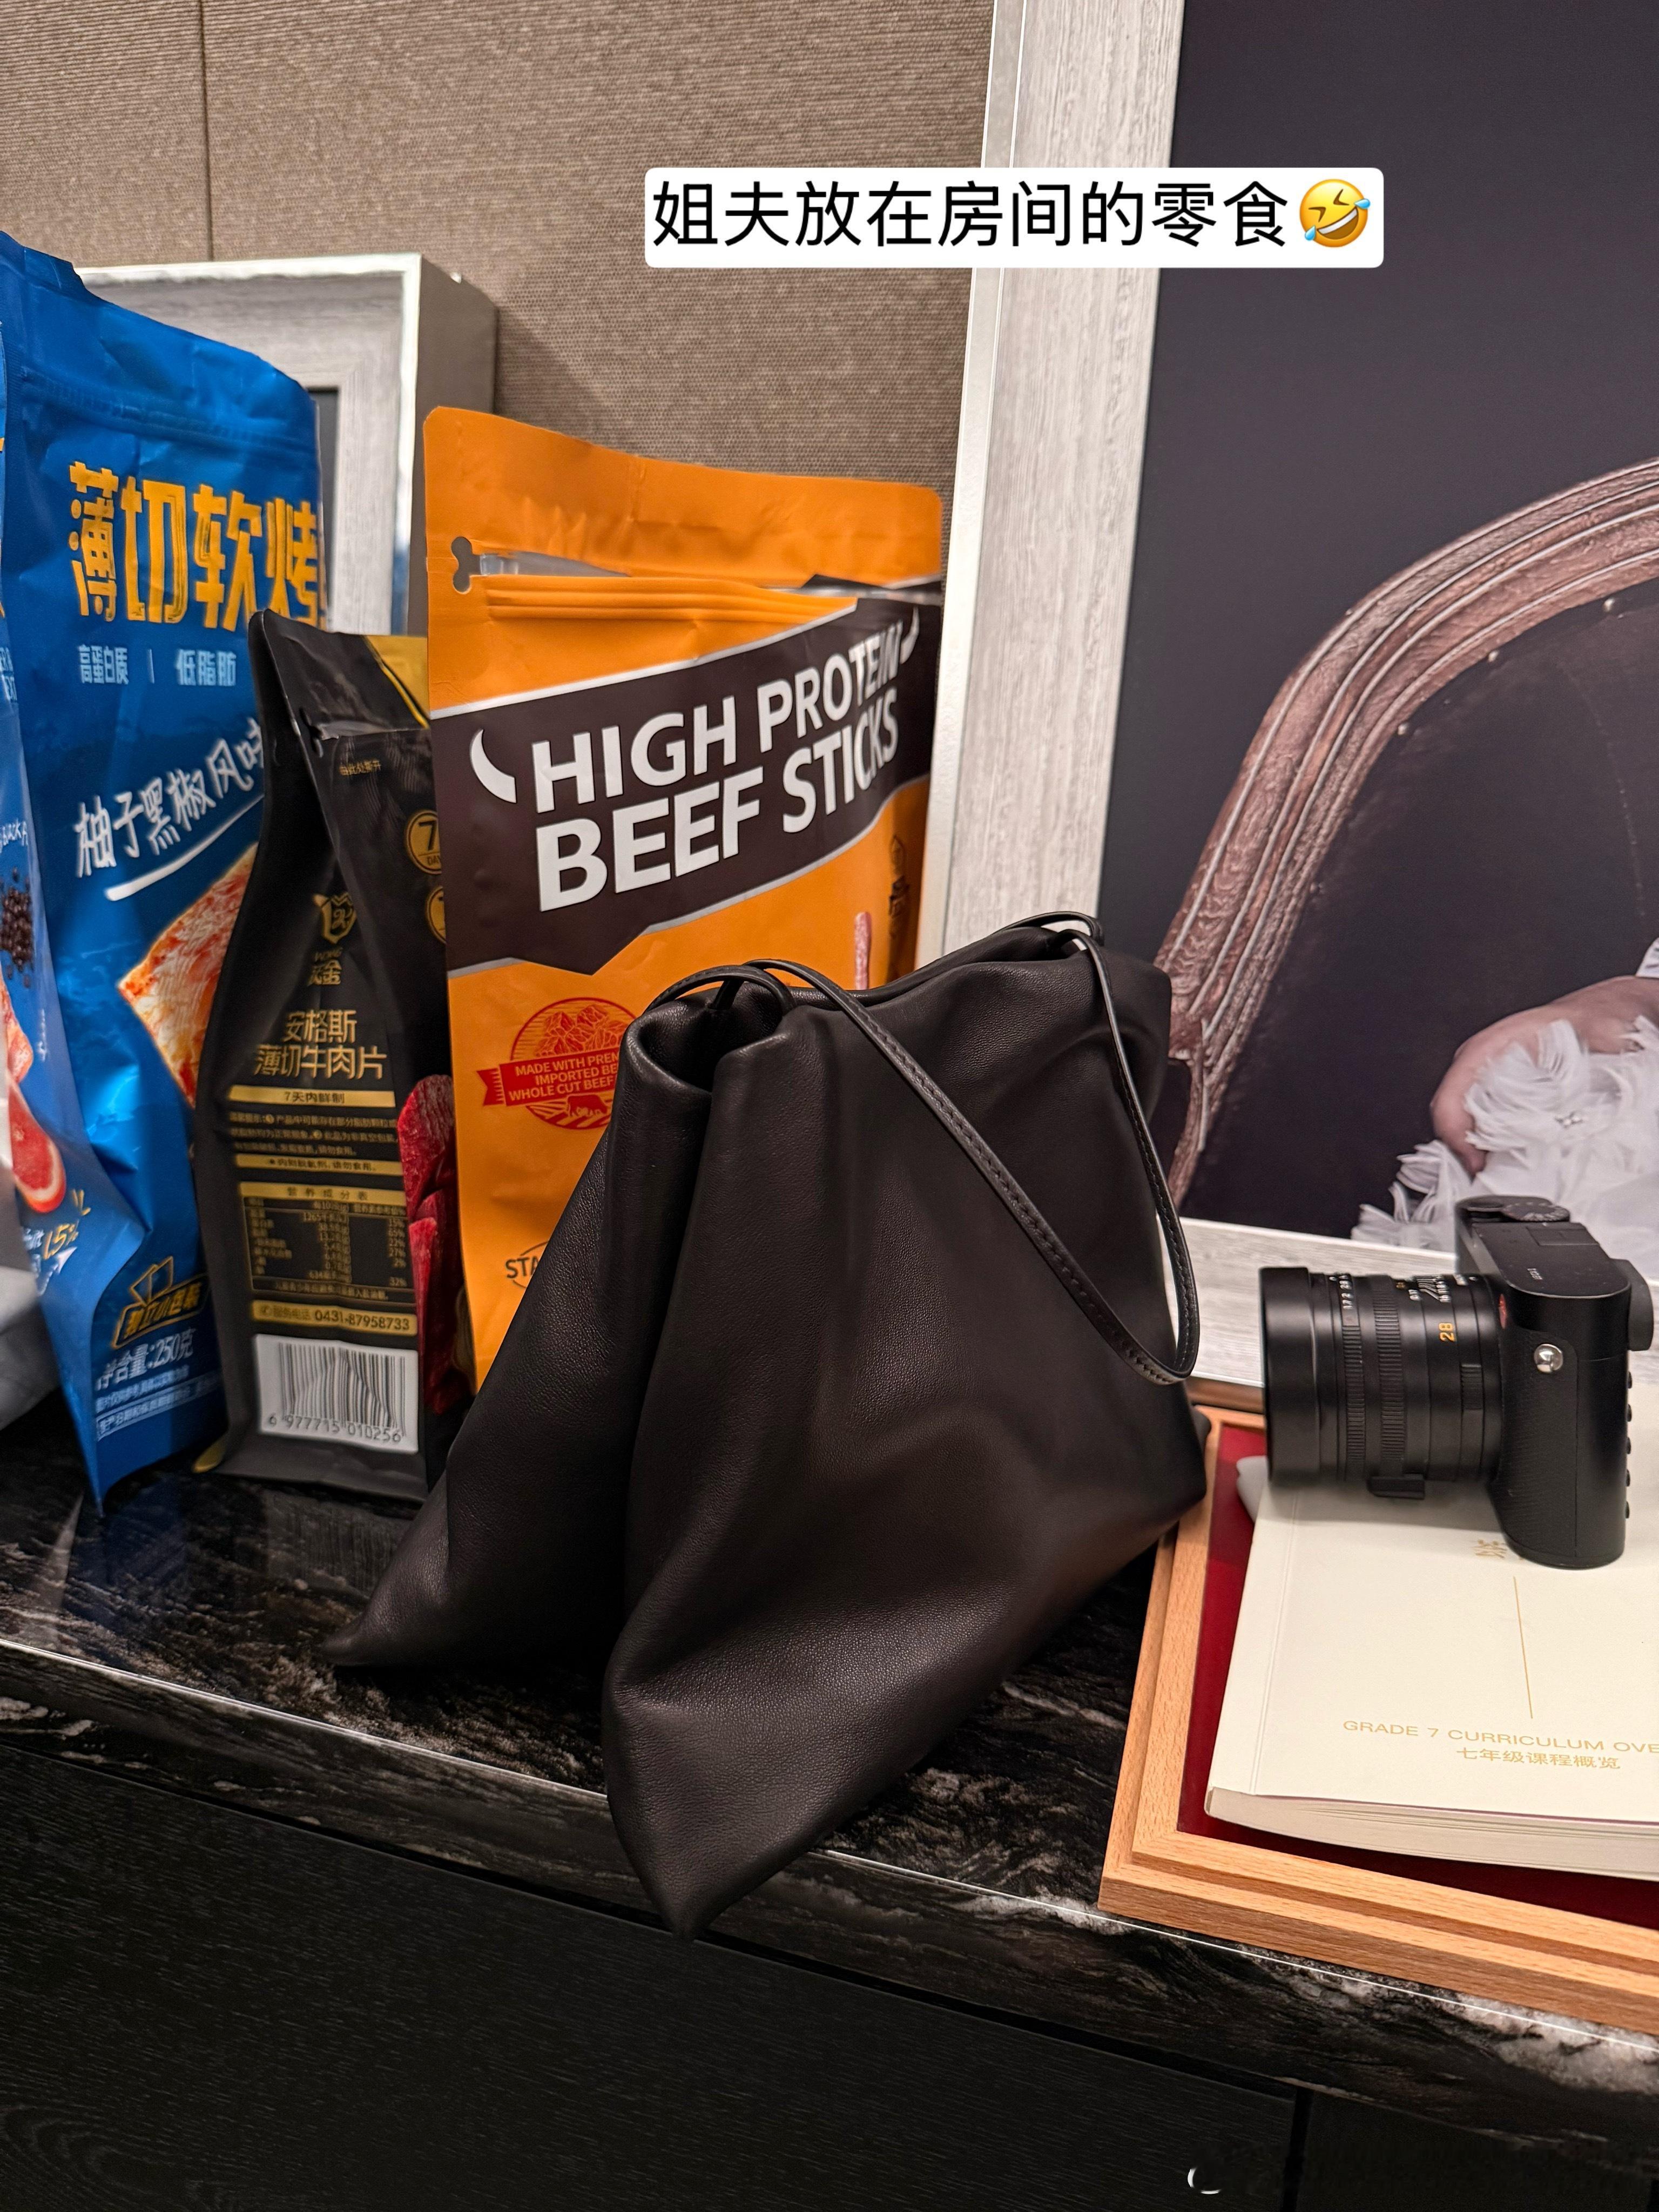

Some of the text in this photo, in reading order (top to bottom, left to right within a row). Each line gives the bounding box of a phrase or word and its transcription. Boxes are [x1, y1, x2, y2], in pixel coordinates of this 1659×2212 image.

[175, 649, 237, 686] 低脂肪
[532, 621, 904, 813] HIGH PROTEIN
[536, 686, 898, 912] BEEF STICKS
[419, 820, 437, 851] 7
[282, 1009, 357, 1043] 安格斯
[254, 1044, 387, 1080] 薄切牛肉片
[516, 1062, 551, 1076] MADE
[552, 1056, 584, 1071] WITH
[535, 1067, 599, 1085] IMPORTED
[508, 1075, 614, 1101] WHOLE CUT BEEF
[315, 1309, 410, 1331] 0431-87958733
[1439, 1323, 1456, 1342] 28
[268, 1414, 277, 1426] 6
[347, 1422, 401, 1443] 010256
[1343, 1721, 1419, 1736] GRADE
[1427, 1728, 1439, 1738] 7
[1448, 1729, 1604, 1750] CURRICULUM
[1456, 1747, 1621, 1769] 七年级课程概览
